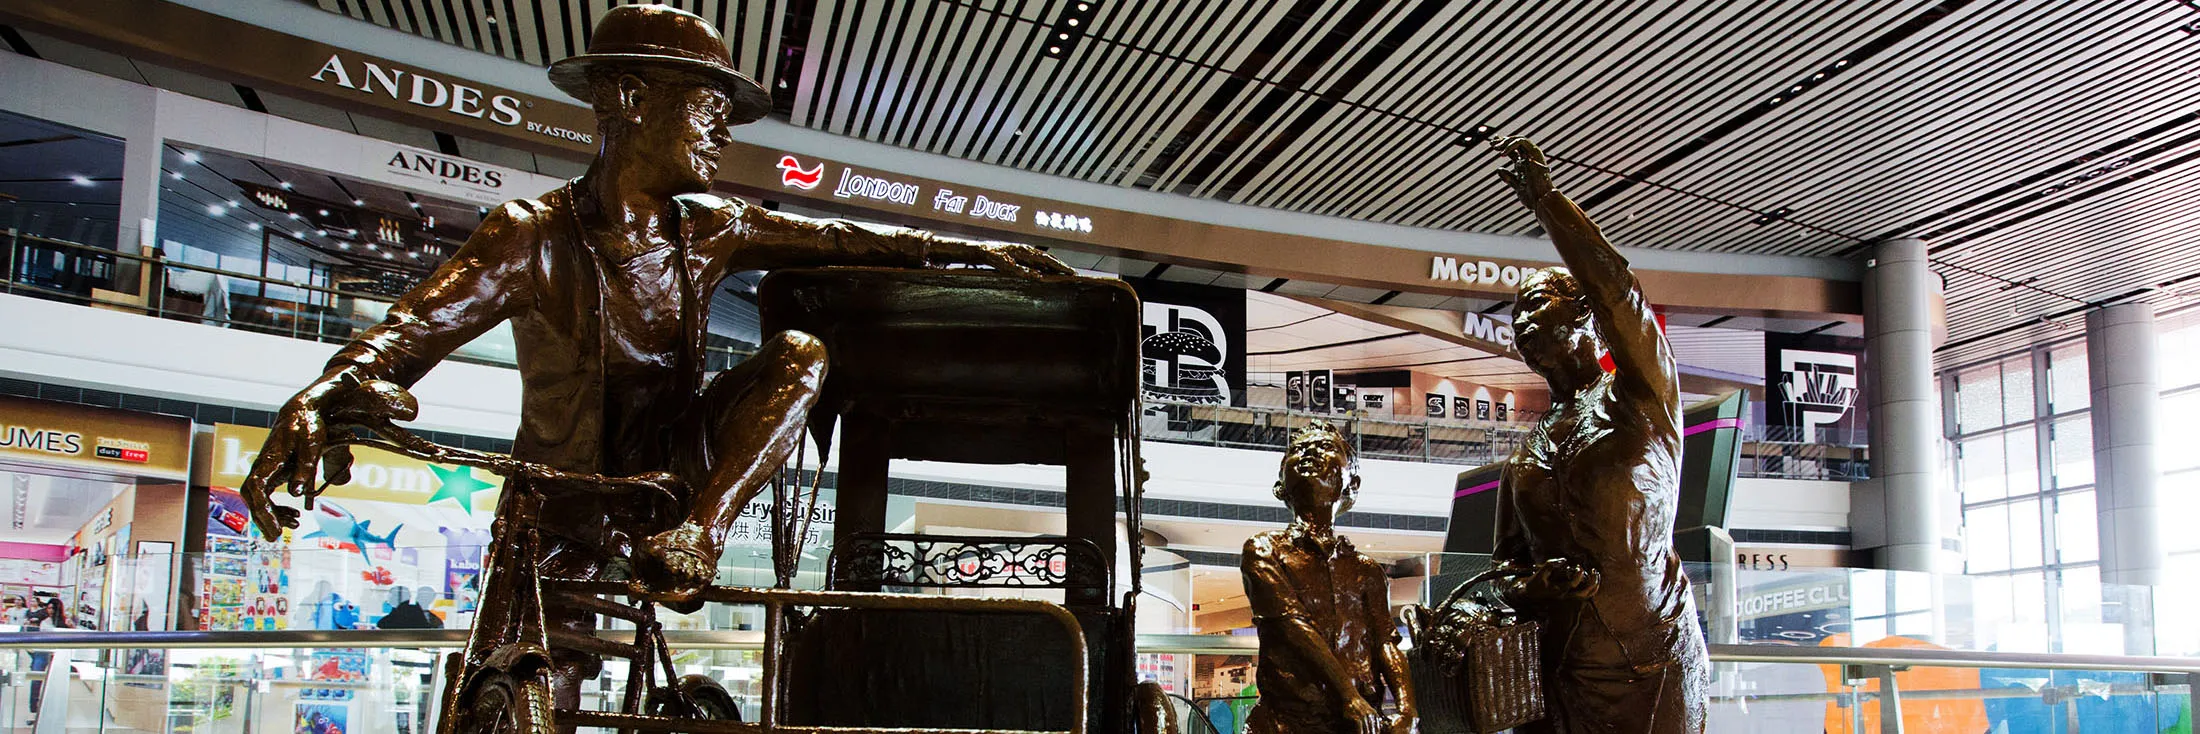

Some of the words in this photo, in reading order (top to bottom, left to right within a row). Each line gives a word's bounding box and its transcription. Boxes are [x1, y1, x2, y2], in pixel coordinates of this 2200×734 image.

[311, 54, 522, 127] ANDES
[526, 120, 543, 133] BY
[543, 126, 593, 145] ASTONS
[388, 150, 503, 189] ANDES
[98, 447, 121, 457] duty
[125, 450, 146, 459] free
